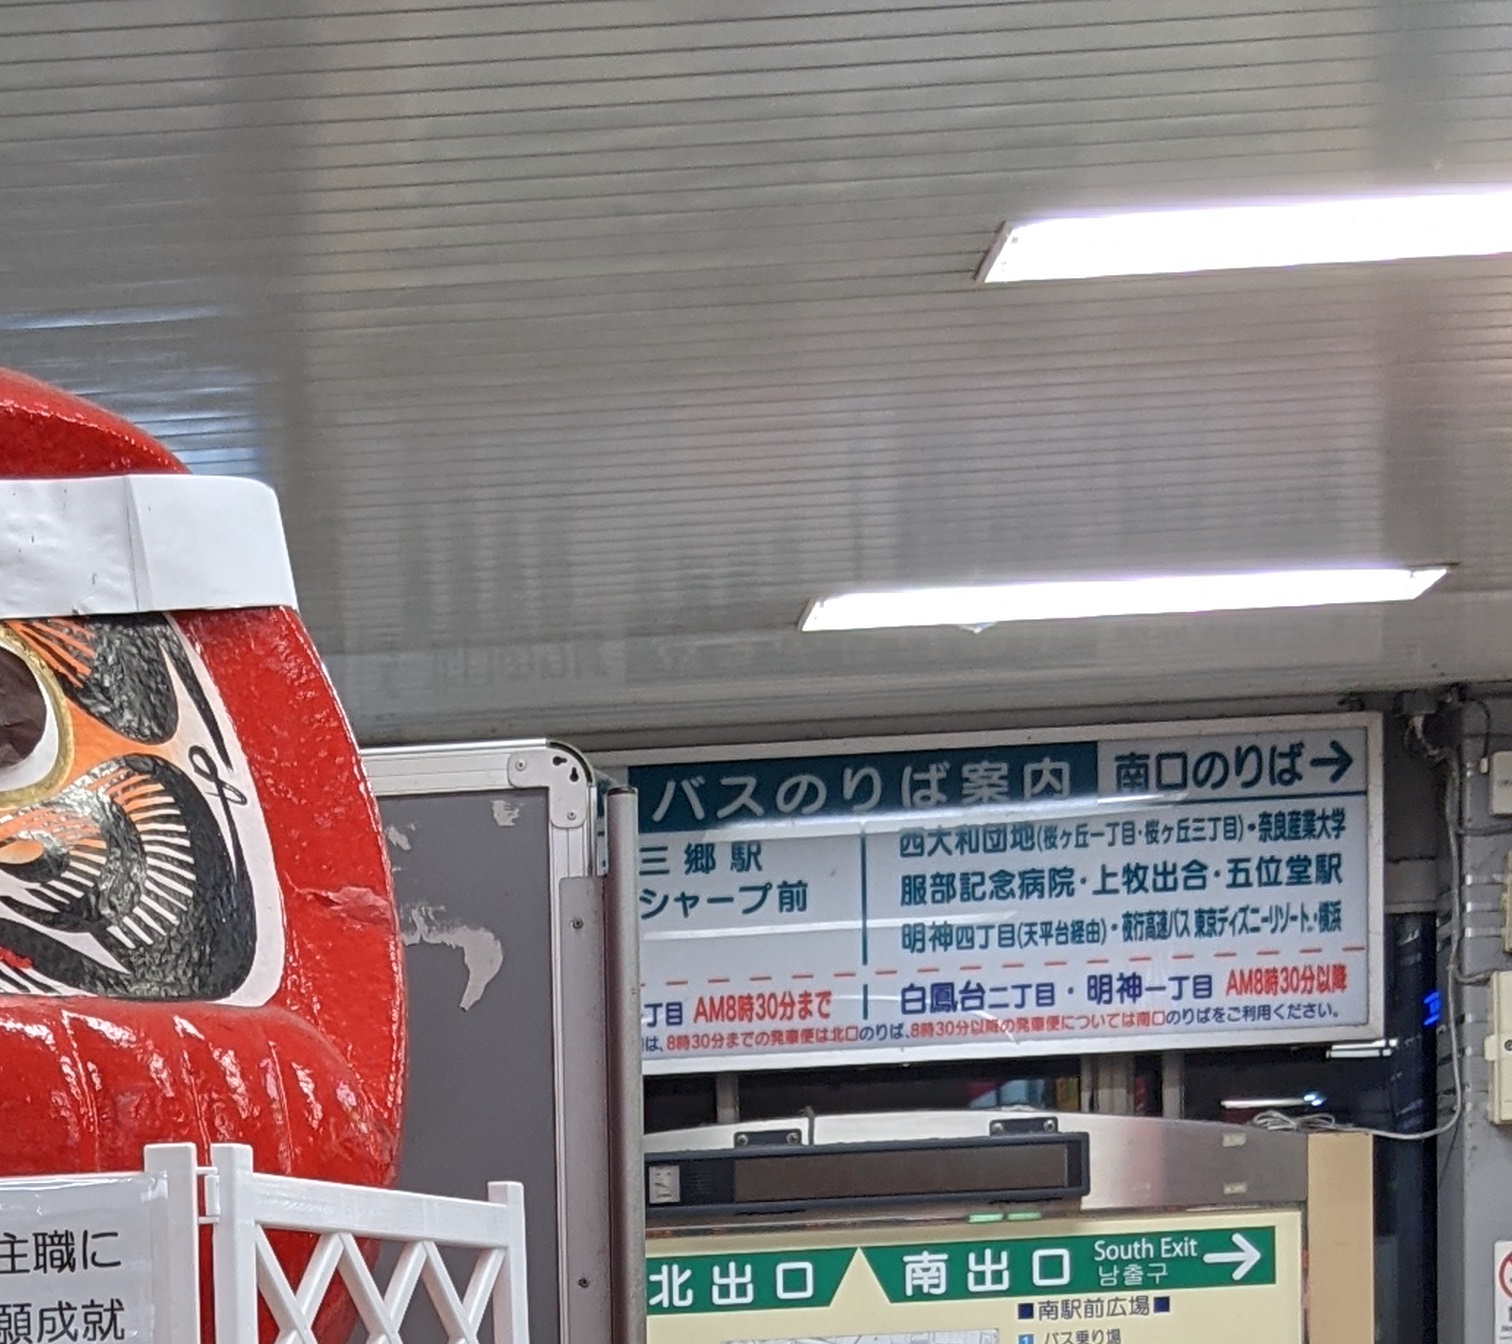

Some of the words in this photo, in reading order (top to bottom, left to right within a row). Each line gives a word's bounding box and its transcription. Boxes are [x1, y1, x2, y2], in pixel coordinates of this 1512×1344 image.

[1115, 744, 1306, 792] 南口のりば
[652, 757, 1071, 822] バスのりば案内
[639, 840, 763, 877] 三郷駅
[639, 880, 808, 920] シャープ前
[1226, 964, 1349, 998] AM8時30分以降
[693, 990, 832, 1024] AM8時30分まで
[1094, 1239, 1155, 1262] South
[1161, 1237, 1198, 1259] Exit
[648, 1261, 815, 1308] 北出口
[903, 1249, 1071, 1297] 南出口
[1098, 1263, 1169, 1288] 남출구
[1038, 1296, 1150, 1323] 南駅前広場
